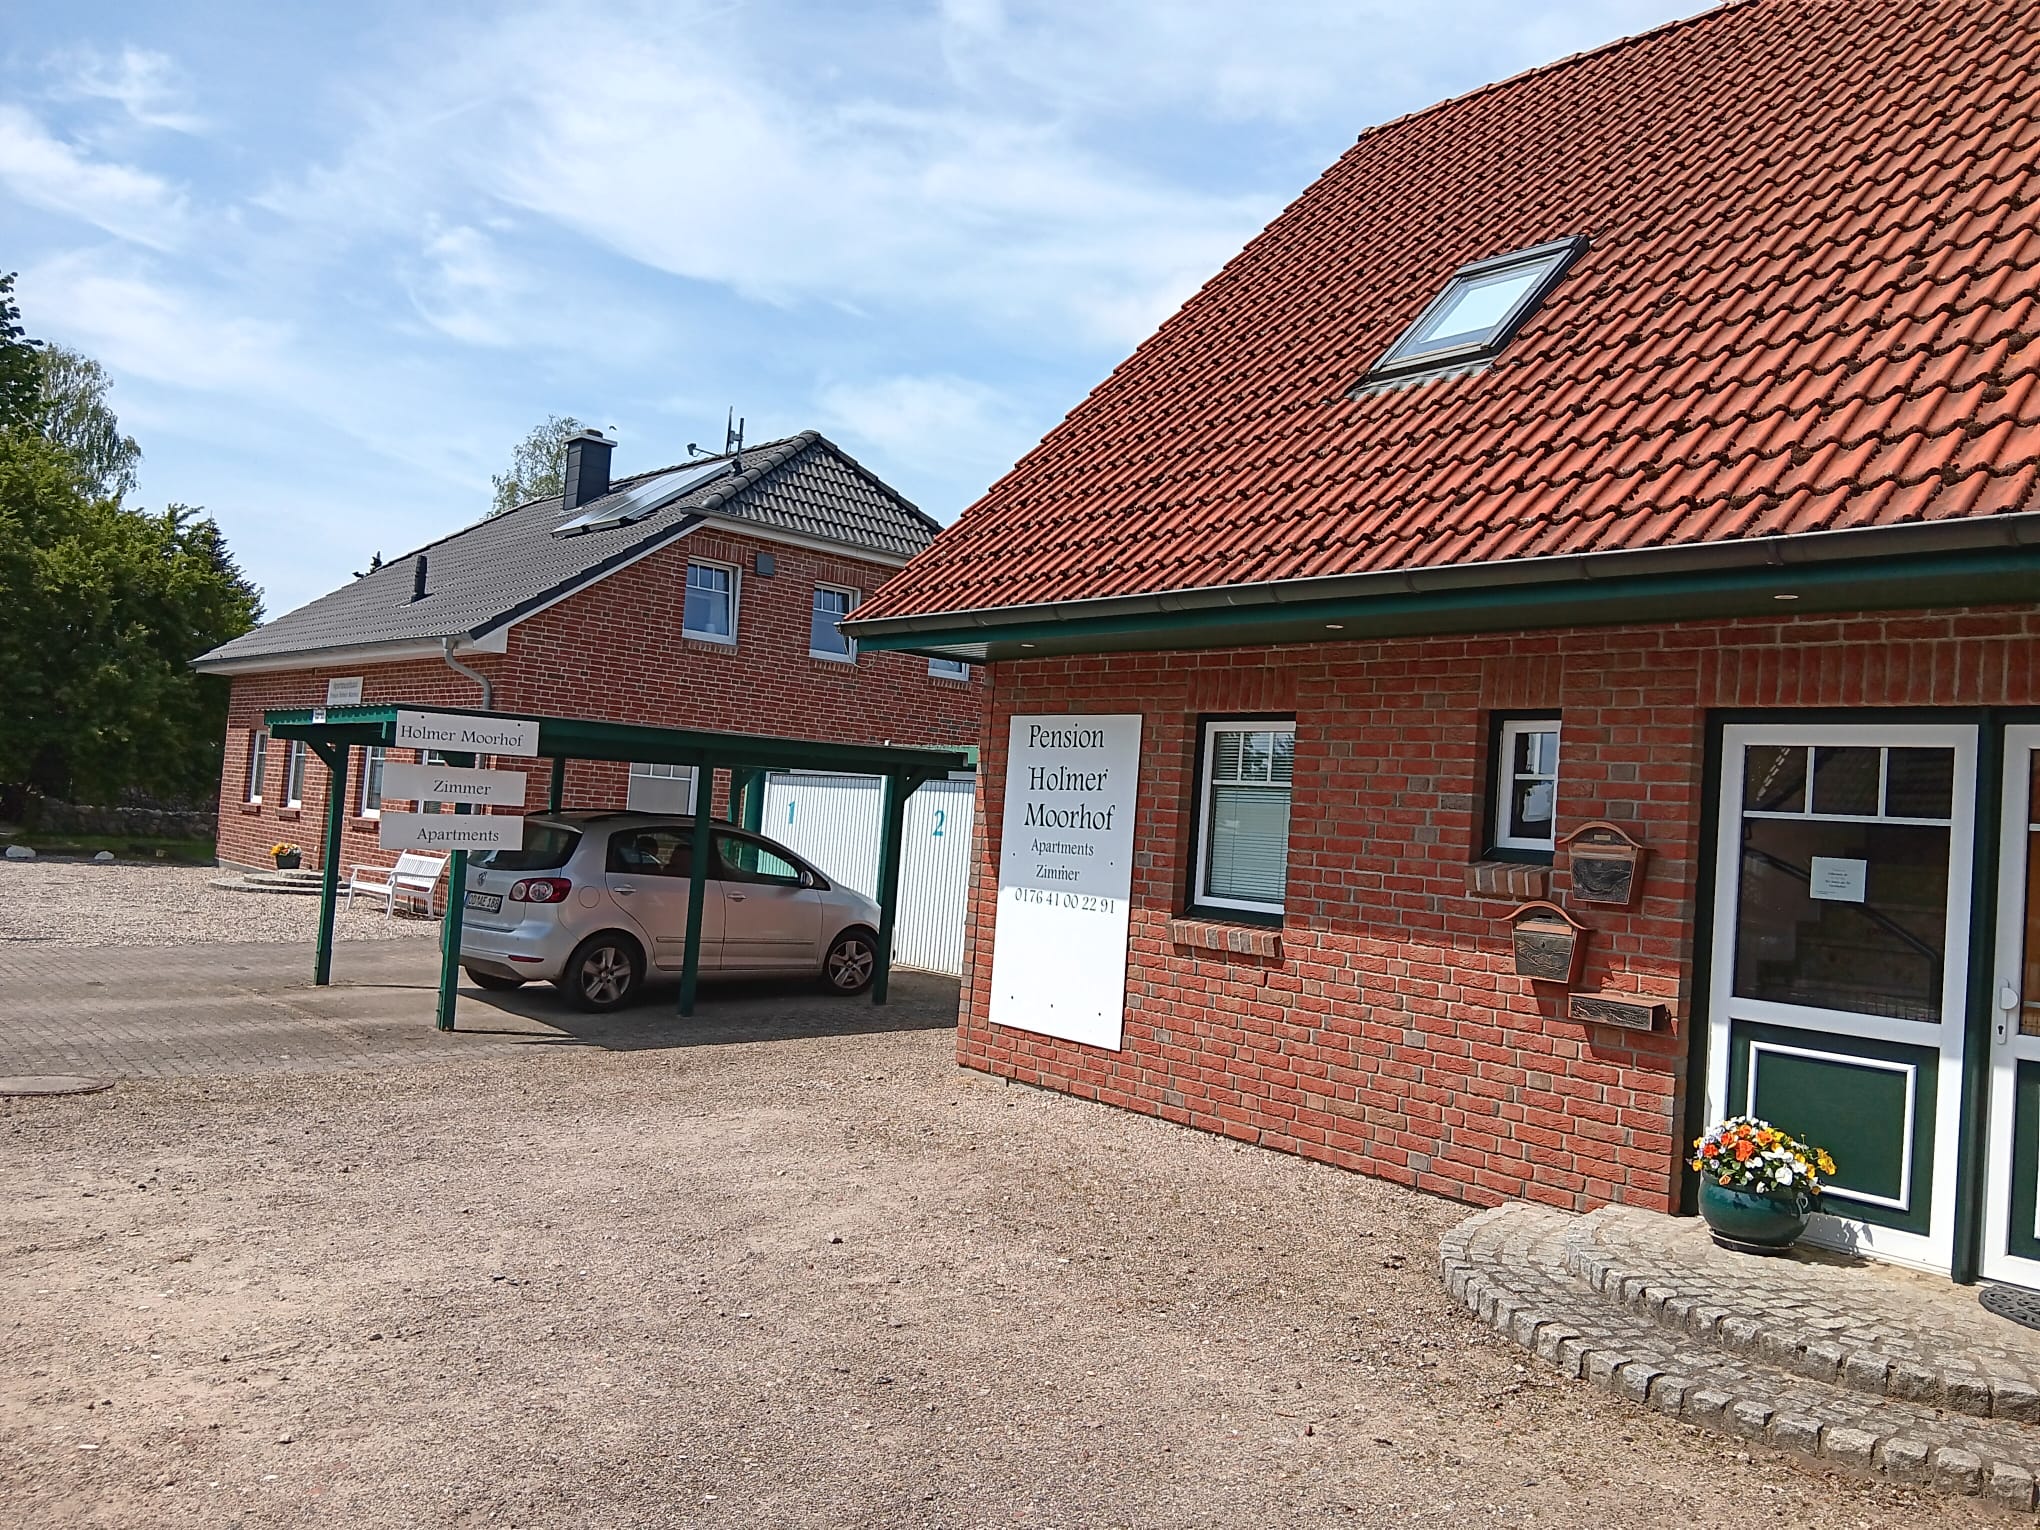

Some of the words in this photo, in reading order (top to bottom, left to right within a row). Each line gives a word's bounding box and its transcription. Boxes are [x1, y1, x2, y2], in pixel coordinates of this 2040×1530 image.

[400, 725, 456, 742] Holmer
[461, 730, 524, 747] Moorhof
[1028, 723, 1105, 749] Pension
[433, 779, 492, 795] Zimmer
[1028, 765, 1109, 792] Holmer
[788, 800, 796, 825] 1
[932, 810, 945, 836] 2
[1023, 802, 1116, 830] Moorhof
[416, 827, 500, 843] Apartments
[1031, 837, 1094, 857] Apartments
[1035, 864, 1080, 881] Zimmer
[1015, 887, 1043, 904] 0176
[1046, 892, 1059, 906] 41
[1063, 894, 1079, 909] 00
[1082, 896, 1097, 911] 22
[1100, 898, 1115, 914] 91
